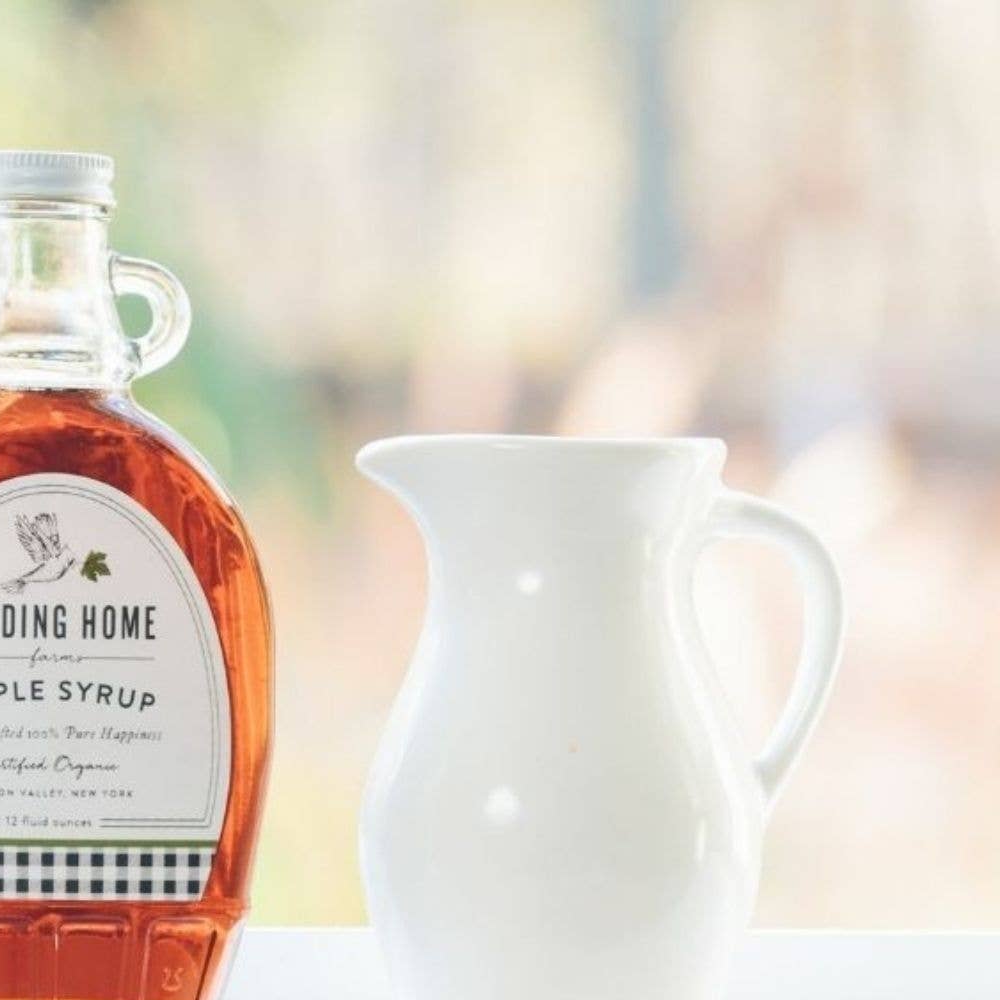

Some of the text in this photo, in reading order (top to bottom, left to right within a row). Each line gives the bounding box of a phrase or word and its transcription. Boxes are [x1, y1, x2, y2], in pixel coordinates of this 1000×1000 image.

[82, 605, 156, 640] HOME
[29, 647, 83, 668] farms
[59, 681, 155, 712] SYRUP
[27, 727, 59, 739] 100%
[65, 725, 96, 740] Pure
[100, 726, 163, 744] Happiness
[53, 754, 120, 780] Organic
[20, 788, 66, 799] VALLEY,
[71, 789, 96, 798] NEW
[101, 789, 134, 799] YORK
[5, 815, 93, 828] 12 fluid ounces
